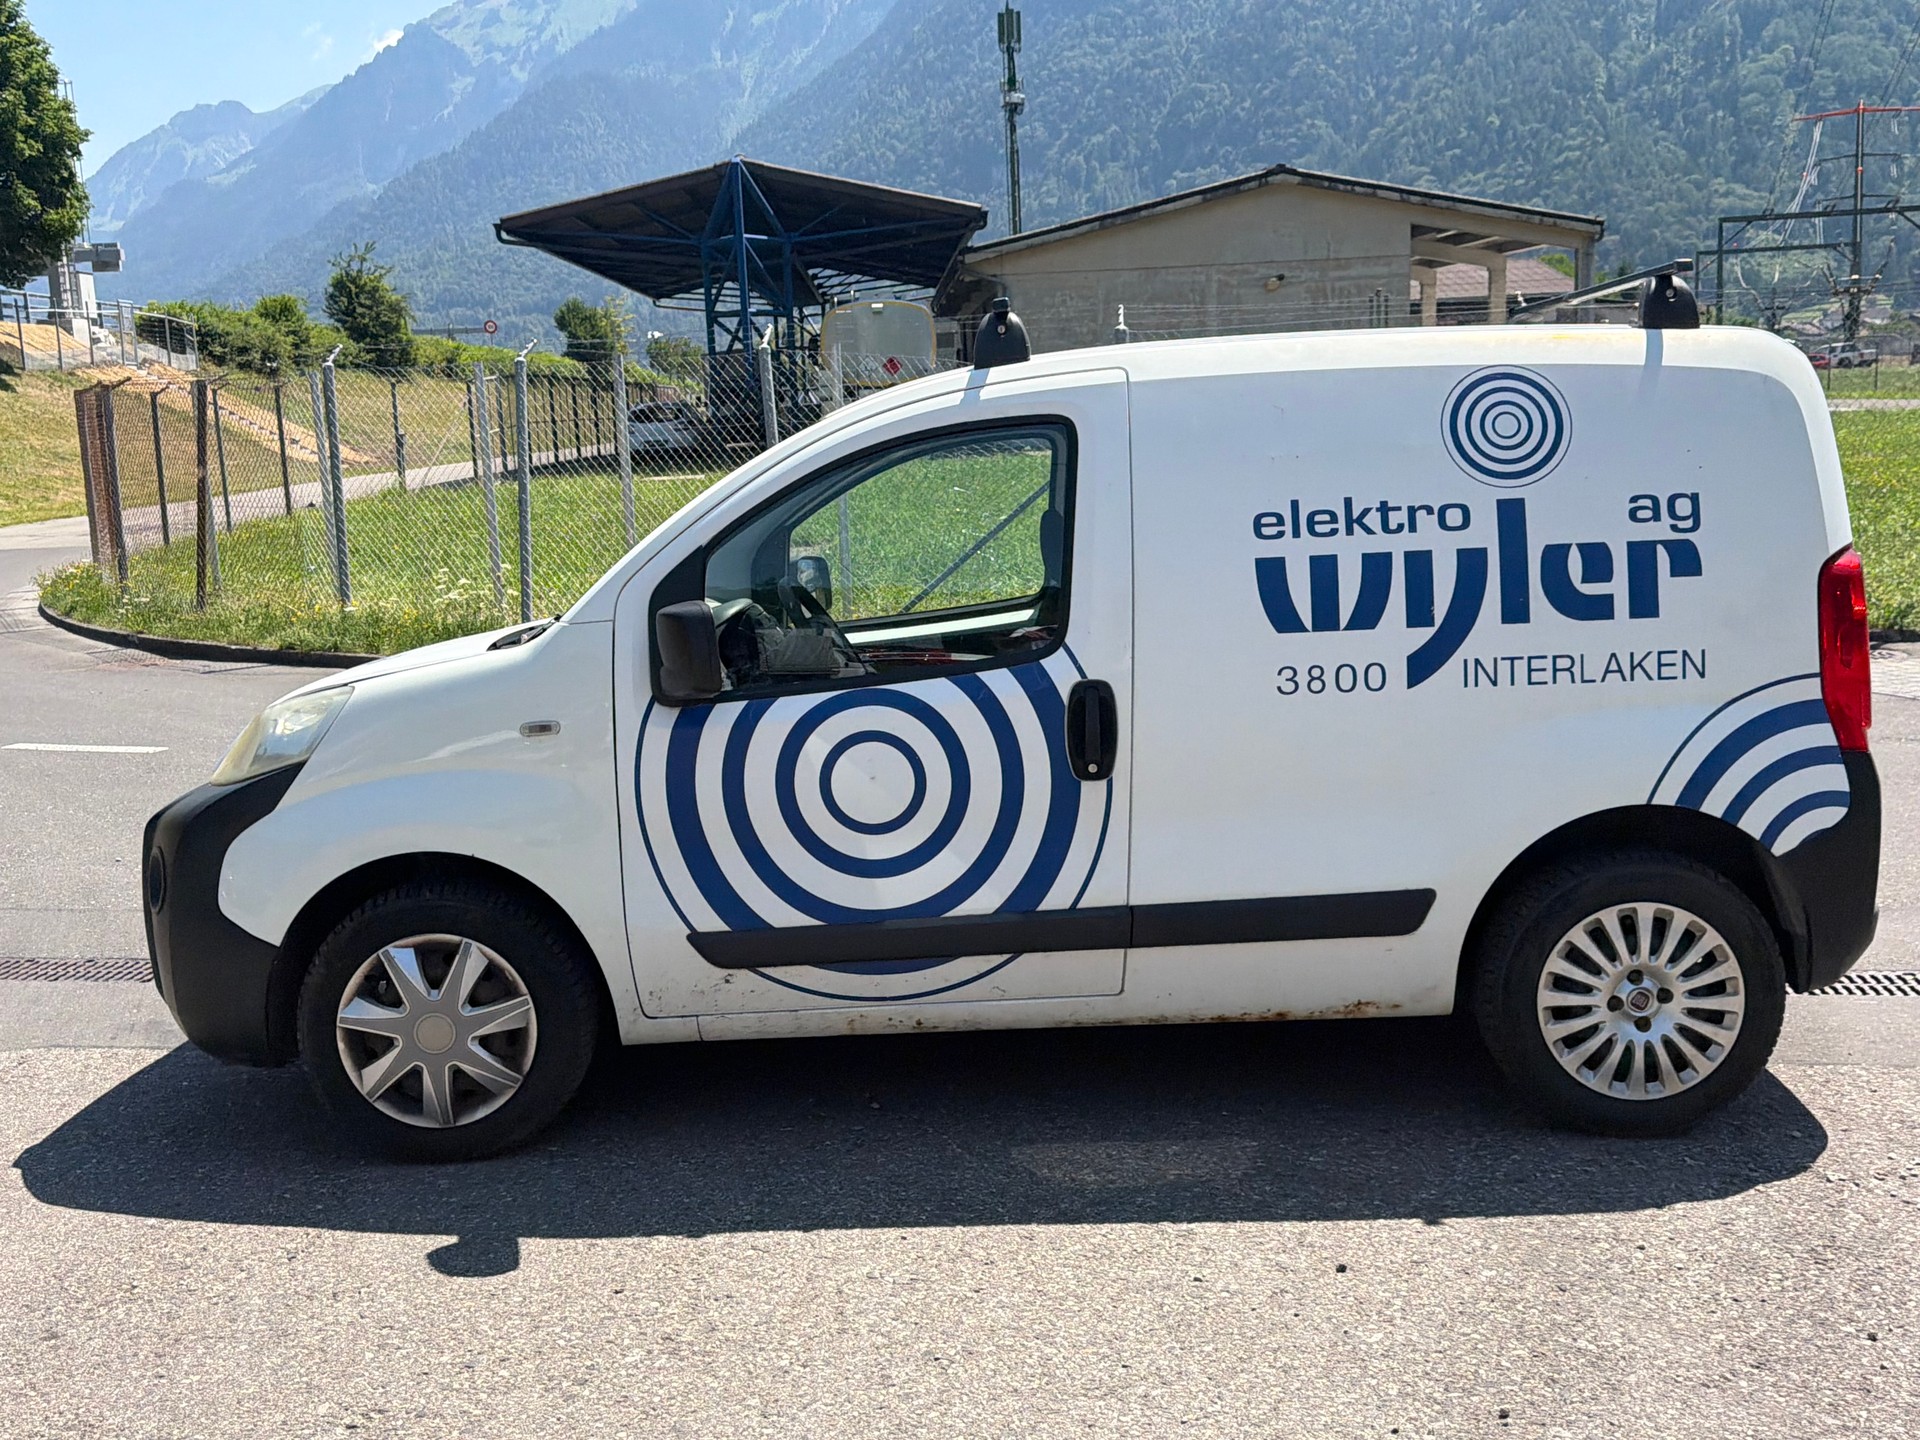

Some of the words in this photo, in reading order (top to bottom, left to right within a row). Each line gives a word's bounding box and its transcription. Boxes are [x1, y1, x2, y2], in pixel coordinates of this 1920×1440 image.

[1252, 496, 1472, 541] elektro
[1627, 491, 1702, 534] ag
[1254, 496, 1704, 690] wyler
[1276, 662, 1388, 696] 3800
[1463, 648, 1707, 689] INTERLAKEN
